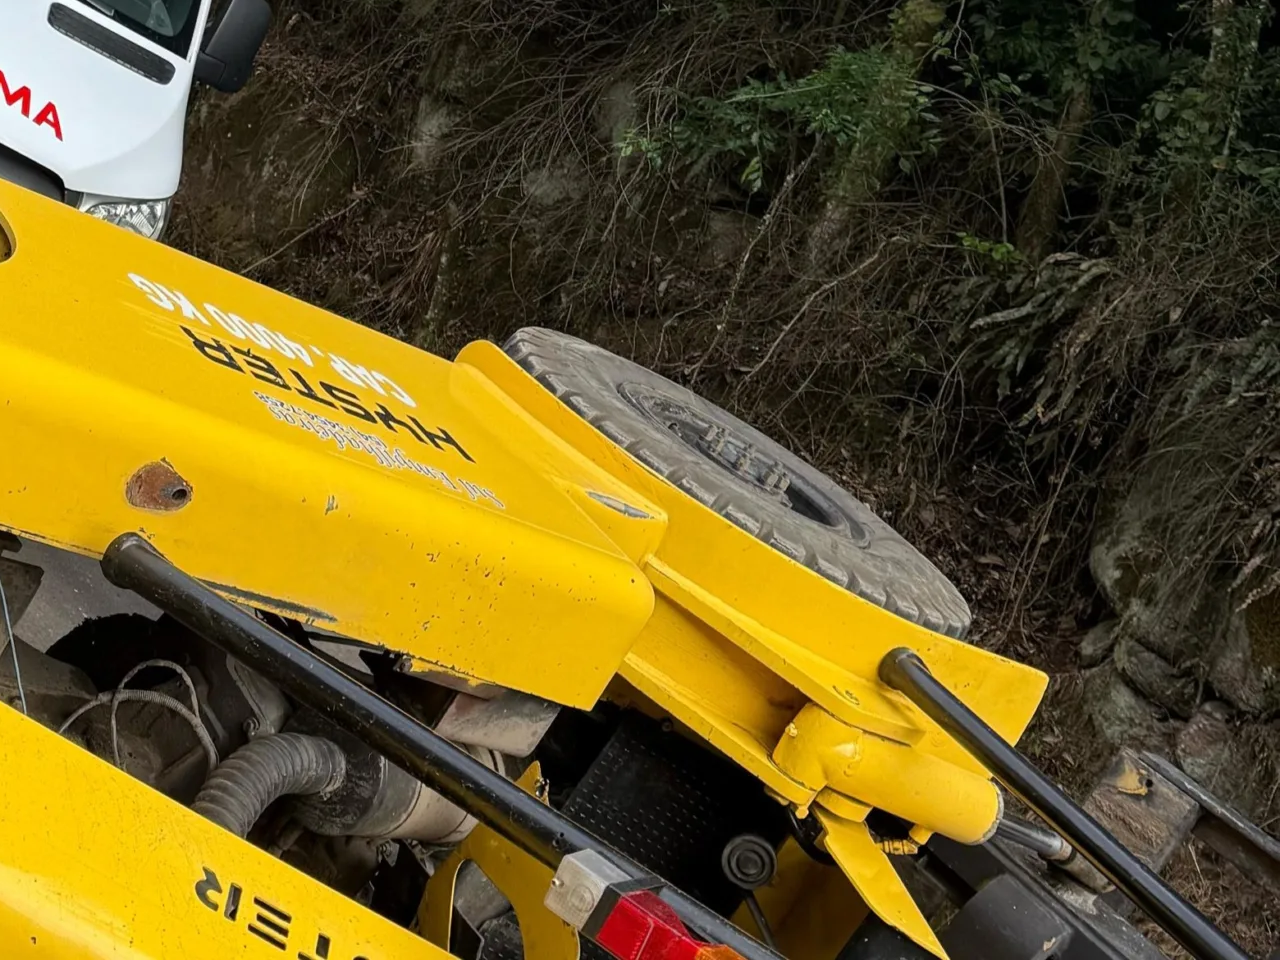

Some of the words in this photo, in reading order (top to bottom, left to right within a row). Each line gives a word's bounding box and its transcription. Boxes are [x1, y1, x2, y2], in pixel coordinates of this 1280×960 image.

[127, 272, 212, 326] KG
[203, 302, 314, 367] 4000
[180, 325, 477, 464] HYSTER
